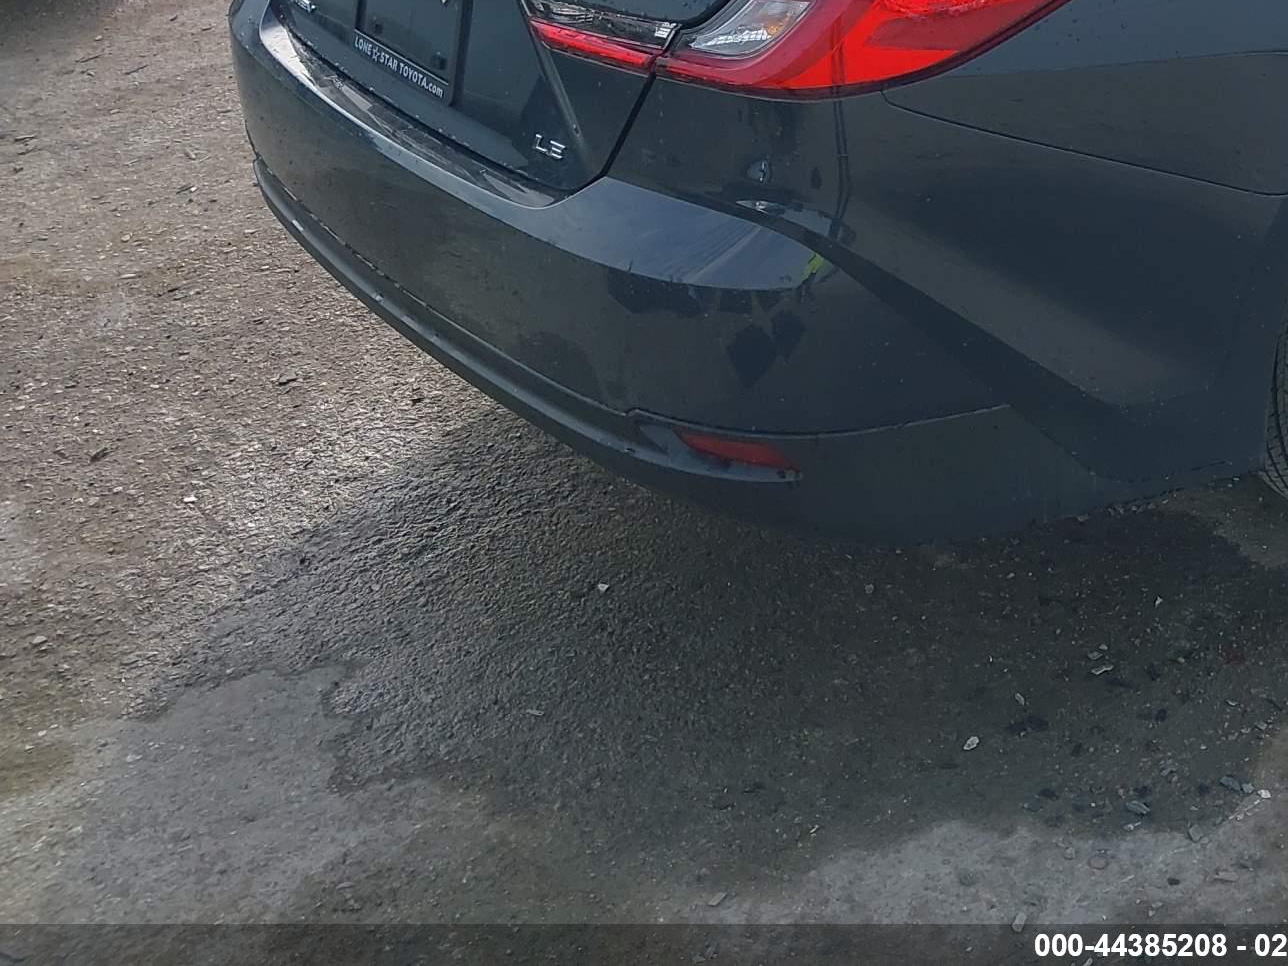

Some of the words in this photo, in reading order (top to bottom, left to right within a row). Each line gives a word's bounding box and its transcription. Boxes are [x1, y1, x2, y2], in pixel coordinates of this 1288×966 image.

[354, 36, 373, 56] LONE
[380, 52, 399, 72] STAR
[399, 62, 444, 98] TOYOTA.com
[534, 134, 566, 159] LE
